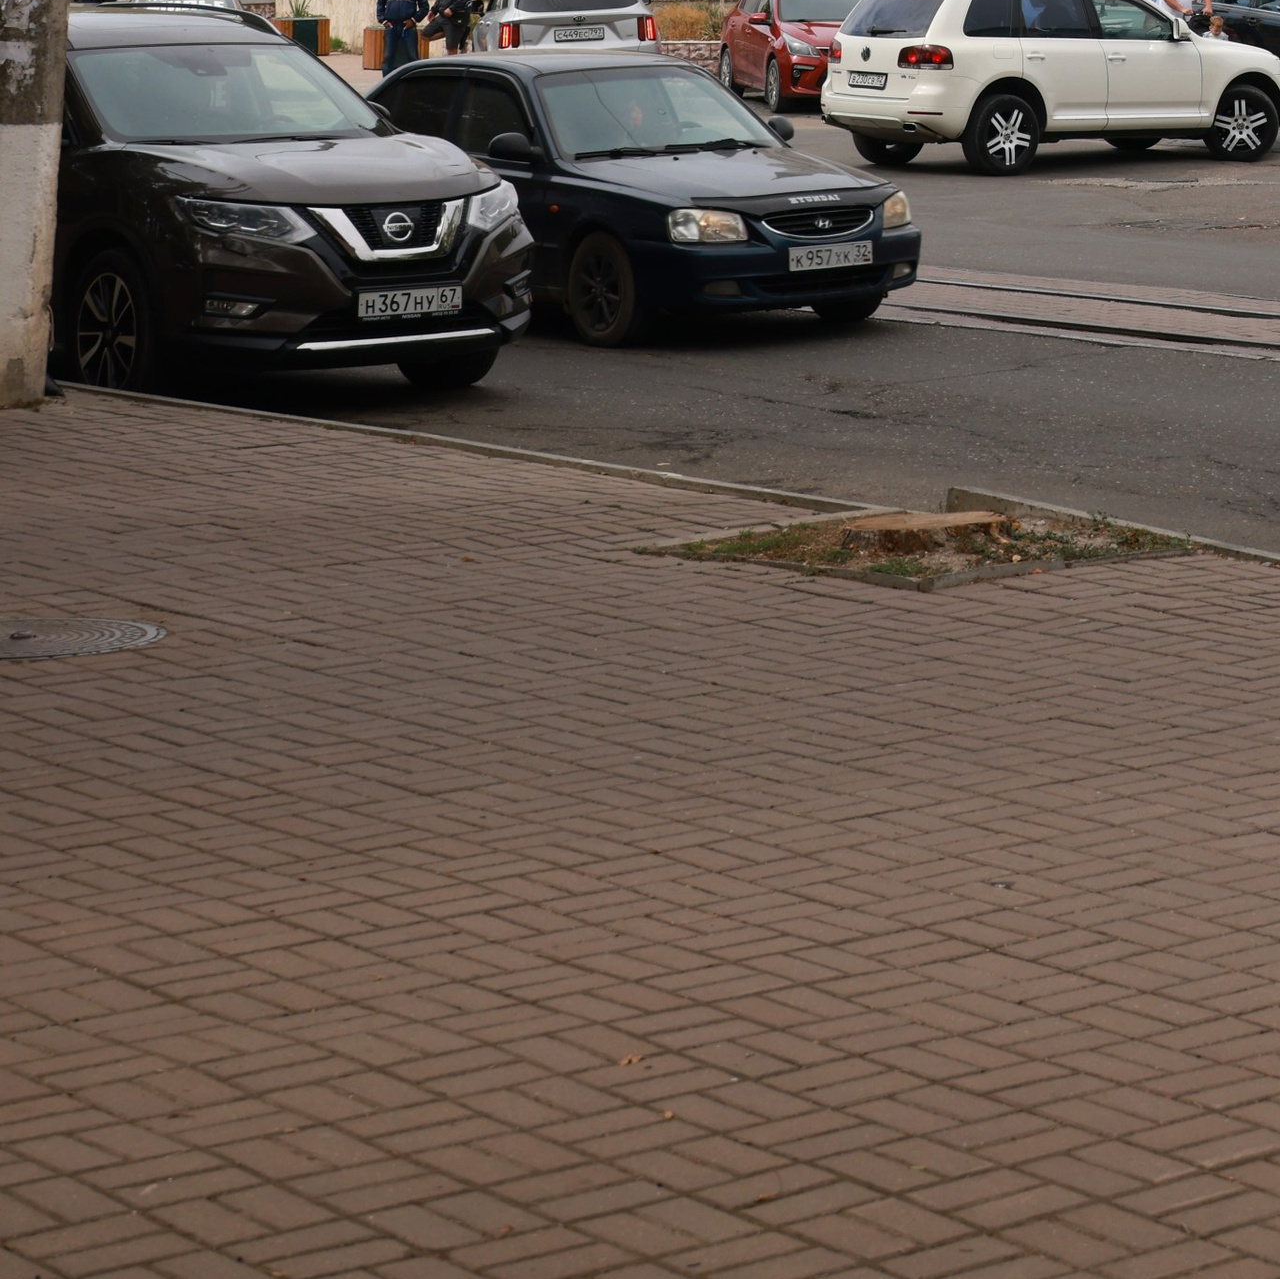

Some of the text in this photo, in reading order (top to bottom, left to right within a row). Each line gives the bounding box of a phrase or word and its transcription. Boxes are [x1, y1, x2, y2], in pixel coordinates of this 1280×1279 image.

[789, 195, 840, 204] HYUNDAI
[855, 244, 868, 258] 32
[365, 288, 457, 315] Н367НУ 67
